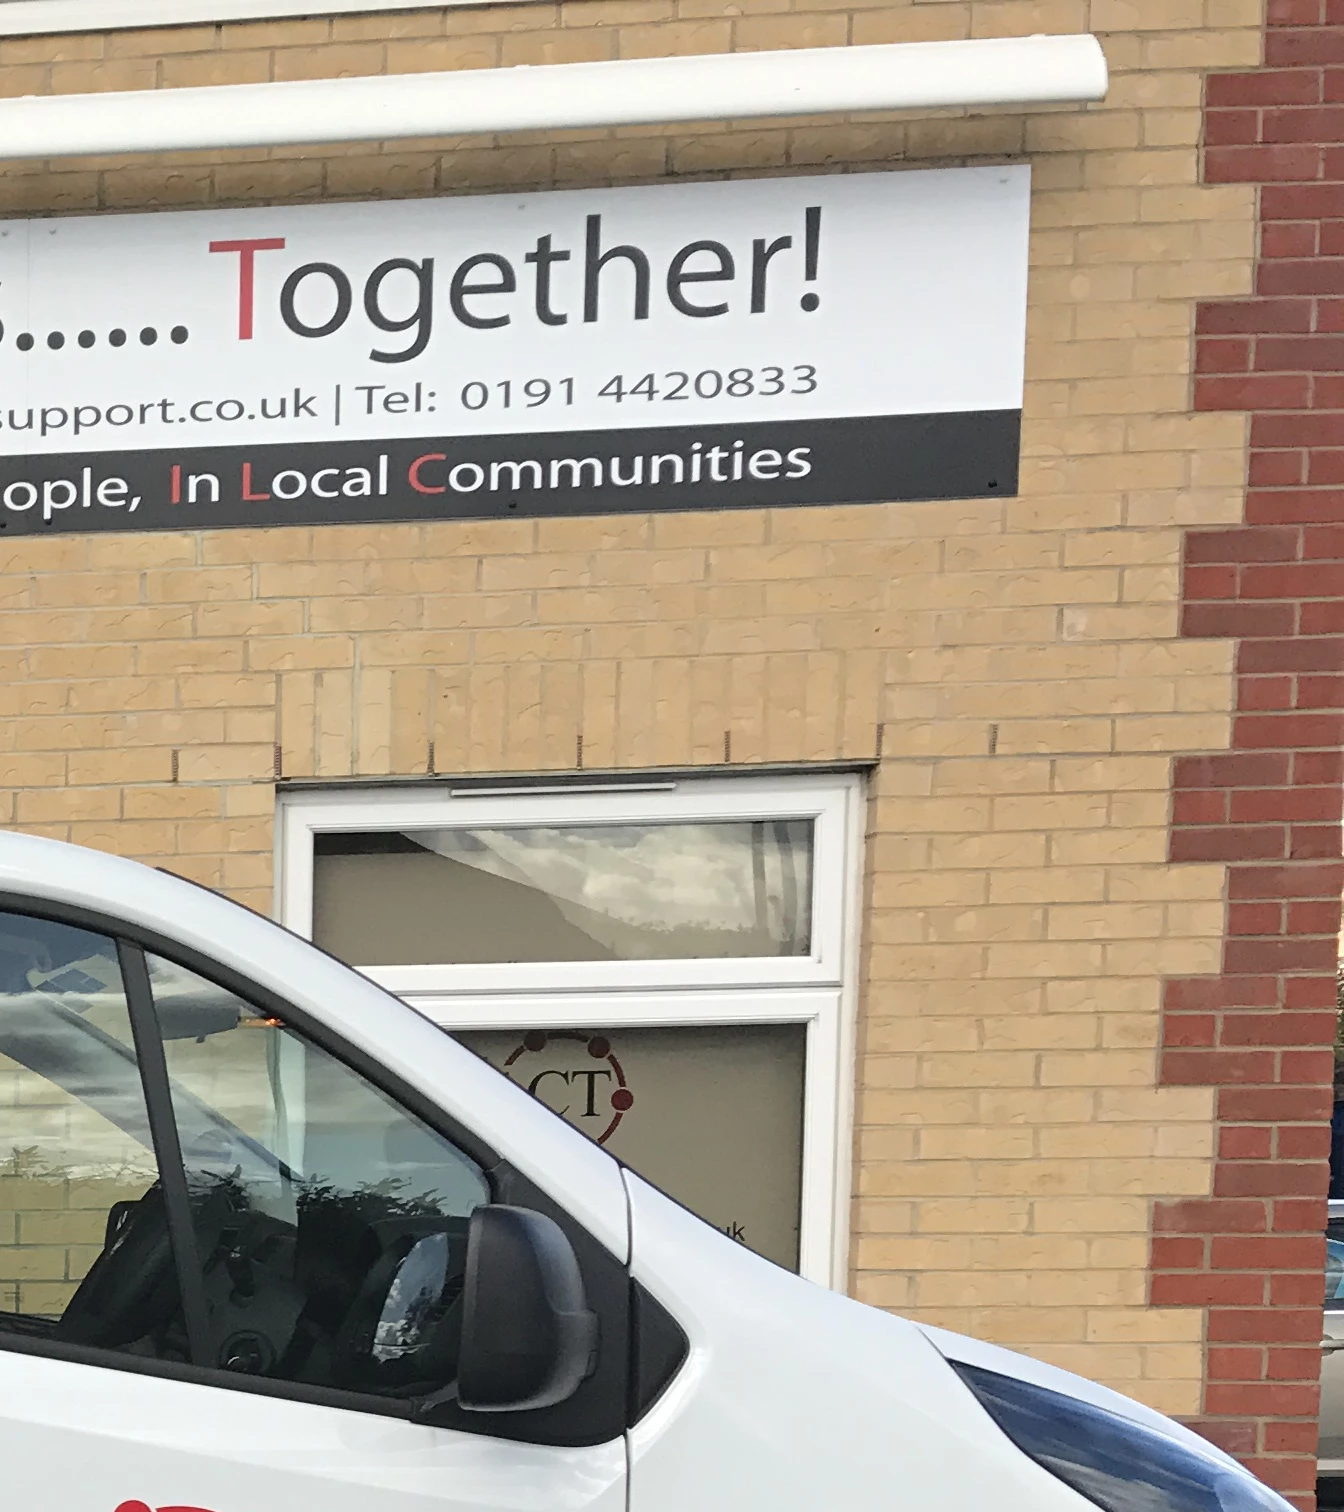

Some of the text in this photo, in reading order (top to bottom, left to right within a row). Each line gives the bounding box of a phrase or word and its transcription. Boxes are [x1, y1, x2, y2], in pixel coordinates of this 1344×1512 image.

[208, 203, 823, 364] Together!
[354, 382, 437, 415] Tel:
[460, 377, 574, 410] 0191
[597, 364, 818, 404] 4420833
[171, 465, 220, 504] In
[242, 454, 388, 501] Local
[408, 439, 812, 494] Communities
